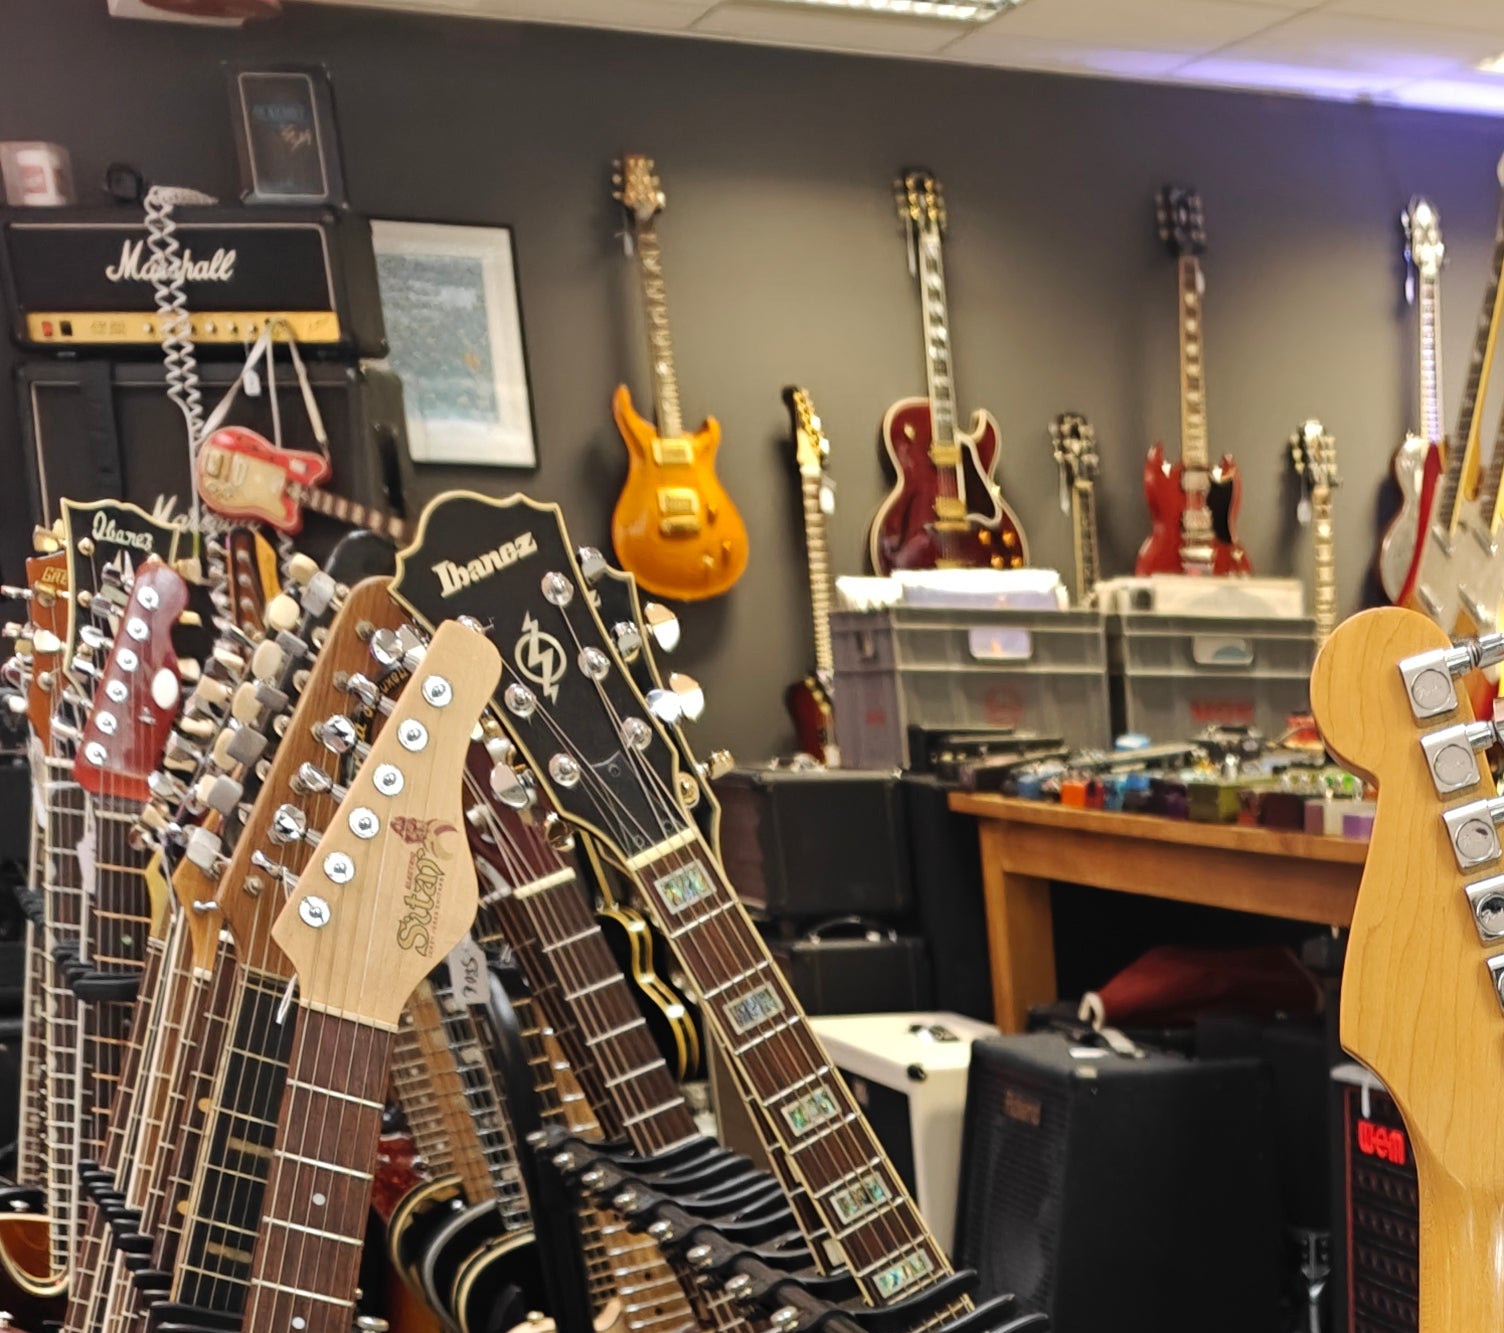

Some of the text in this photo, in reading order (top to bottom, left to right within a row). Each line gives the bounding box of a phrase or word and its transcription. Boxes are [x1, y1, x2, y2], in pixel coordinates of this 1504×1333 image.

[92, 510, 154, 550] Ibanez
[431, 532, 538, 598] Ibanez
[397, 848, 445, 957] Sitar
